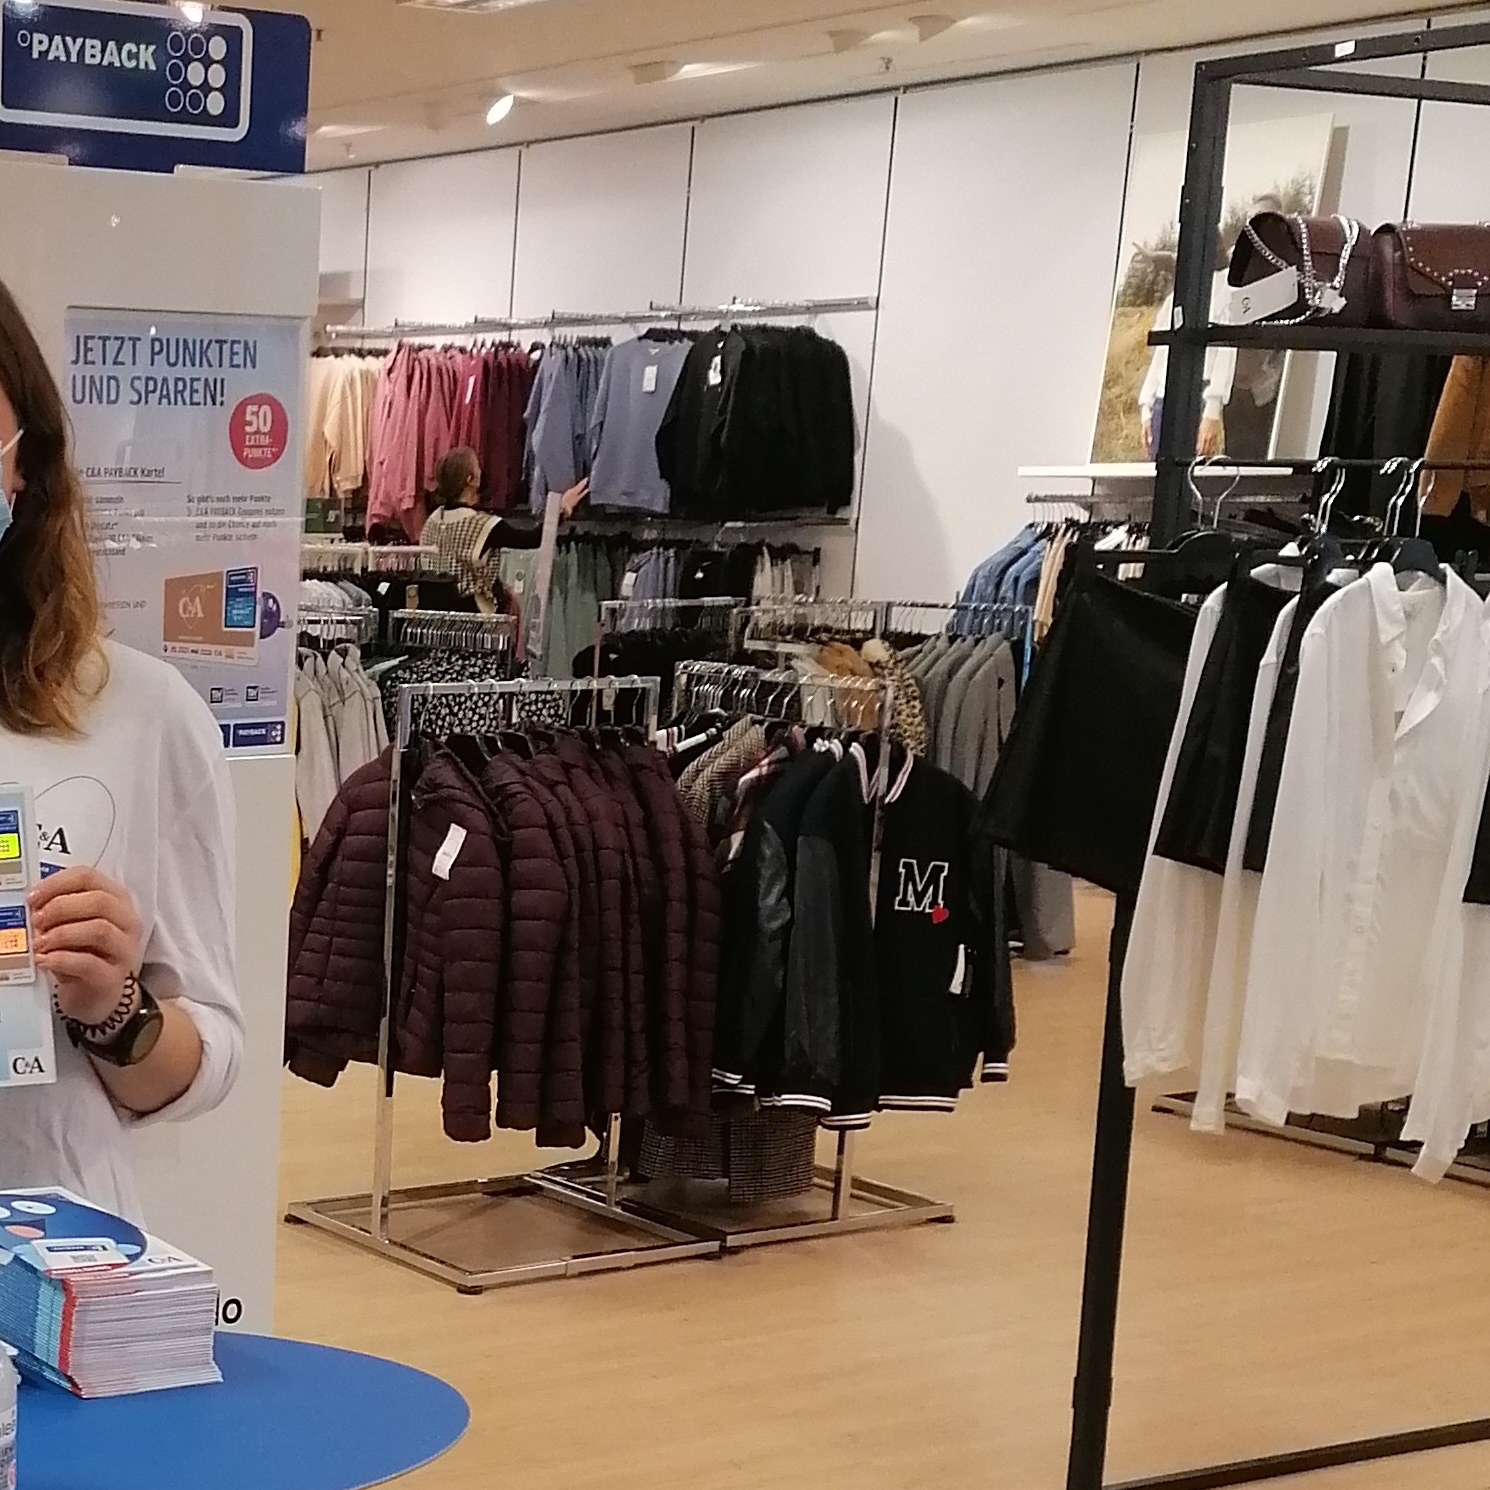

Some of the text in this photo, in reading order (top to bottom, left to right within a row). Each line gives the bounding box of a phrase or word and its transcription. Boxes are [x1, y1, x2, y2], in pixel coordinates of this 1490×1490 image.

[30, 31, 157, 72] PAYBACK
[70, 334, 258, 370] JETZT PUNKTEN
[71, 374, 226, 407] UND SPAREN!
[244, 404, 273, 433] 50
[894, 858, 949, 914] M
[12, 1055, 46, 1076] C&A
